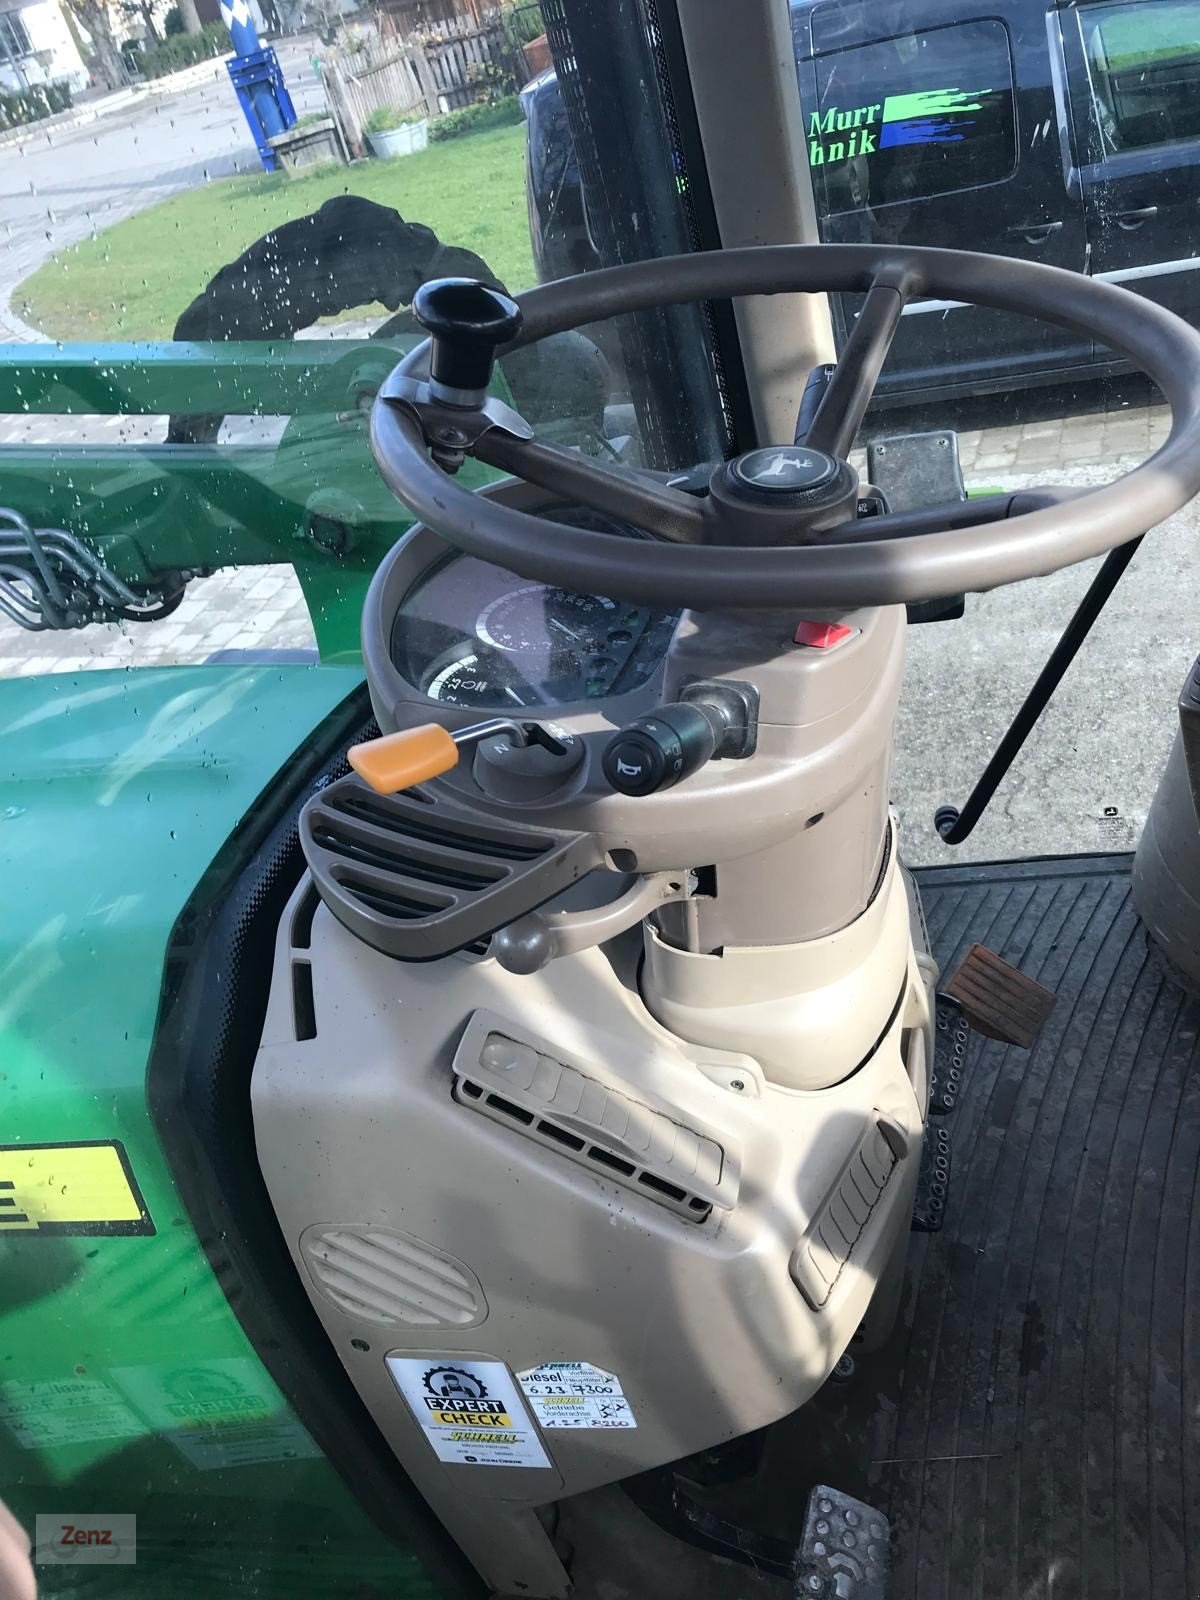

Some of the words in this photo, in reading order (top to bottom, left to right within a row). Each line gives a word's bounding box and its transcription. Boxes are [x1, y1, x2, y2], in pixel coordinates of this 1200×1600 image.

[808, 103, 881, 137] Murr
[810, 129, 877, 166] hnik
[574, 1384, 613, 1396] 7300
[427, 1398, 500, 1413] EXPERT
[440, 1412, 505, 1426] CHECK
